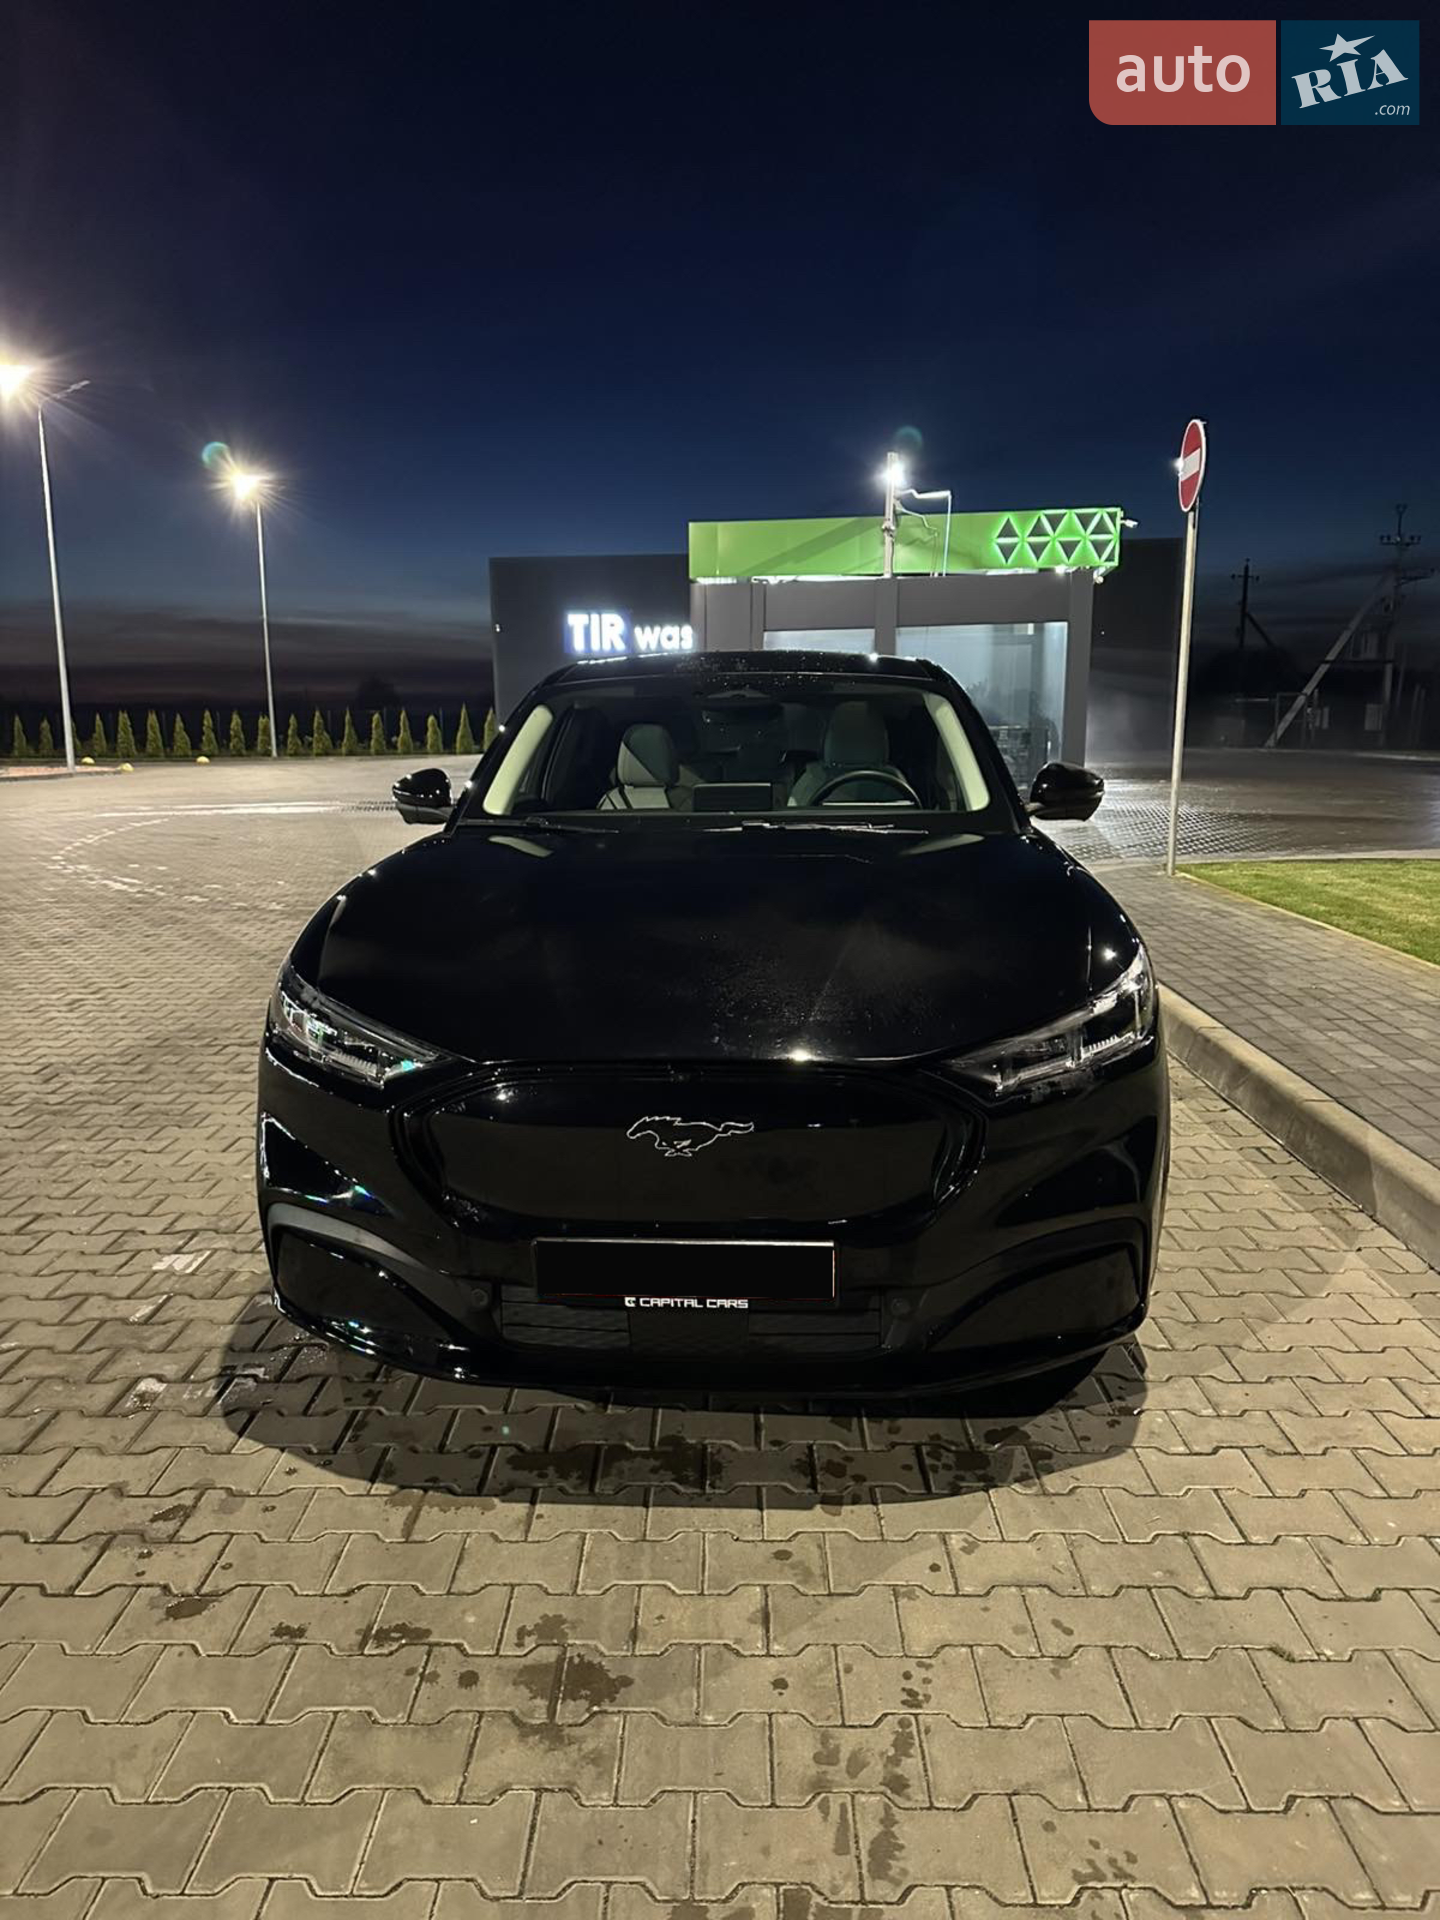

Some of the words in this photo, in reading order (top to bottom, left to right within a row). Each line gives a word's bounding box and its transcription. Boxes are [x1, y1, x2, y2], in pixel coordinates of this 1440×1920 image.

[567, 613, 627, 652] TIR
[639, 1297, 704, 1308] CAPITAL
[706, 1299, 749, 1309] CARS
